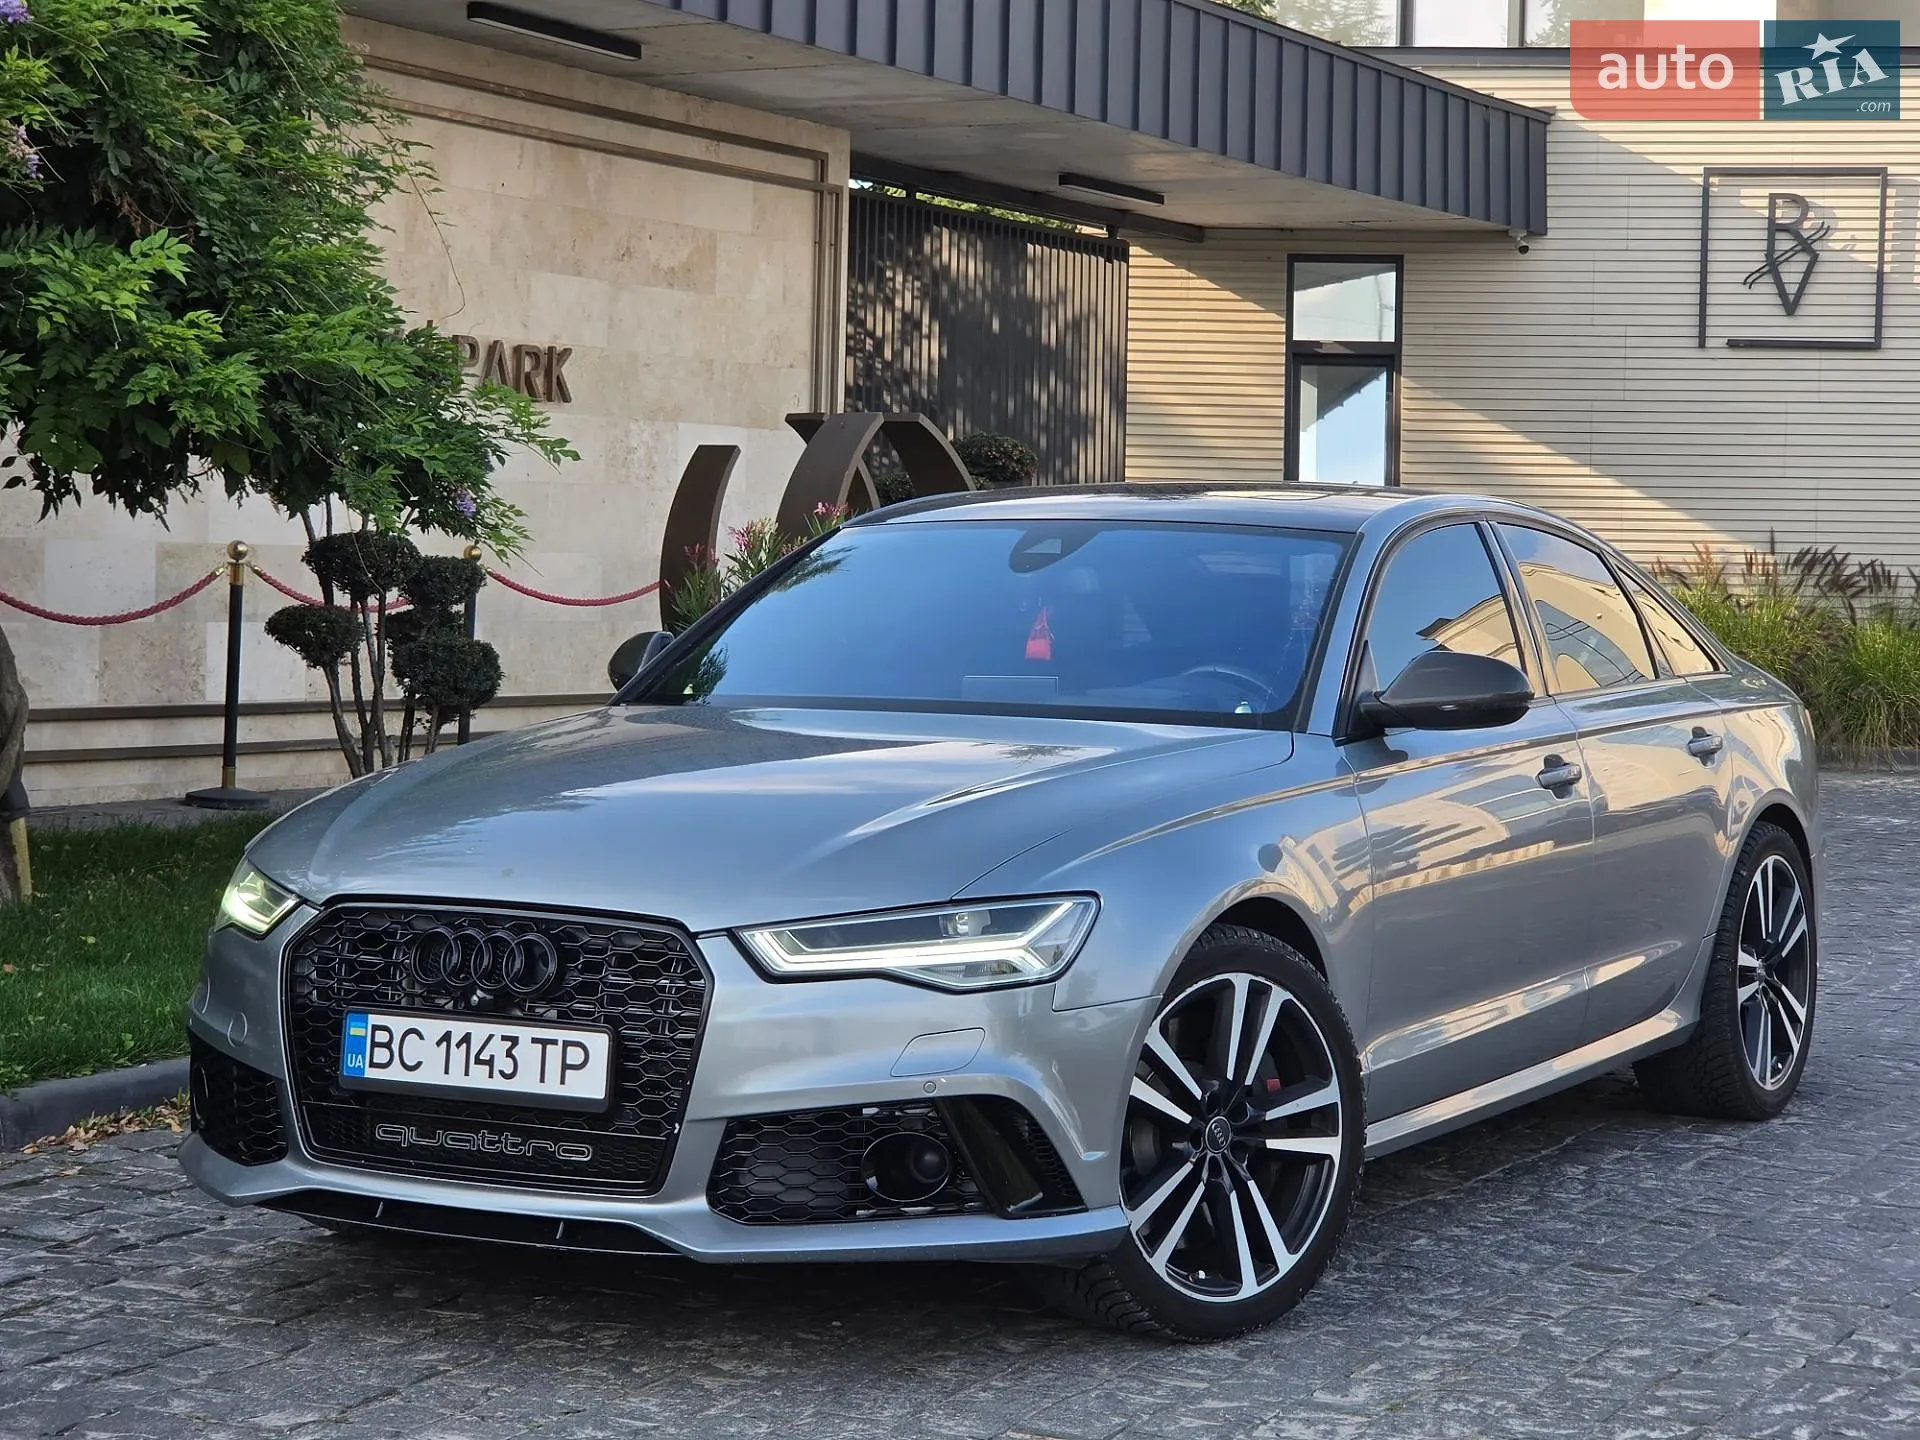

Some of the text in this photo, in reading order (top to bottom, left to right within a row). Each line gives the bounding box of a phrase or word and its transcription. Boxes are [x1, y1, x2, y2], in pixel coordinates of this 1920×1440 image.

[452, 334, 573, 403] PARK
[347, 1053, 364, 1069] UA
[368, 1023, 590, 1085] BC 1143 TP
[375, 1123, 592, 1162] quattro
